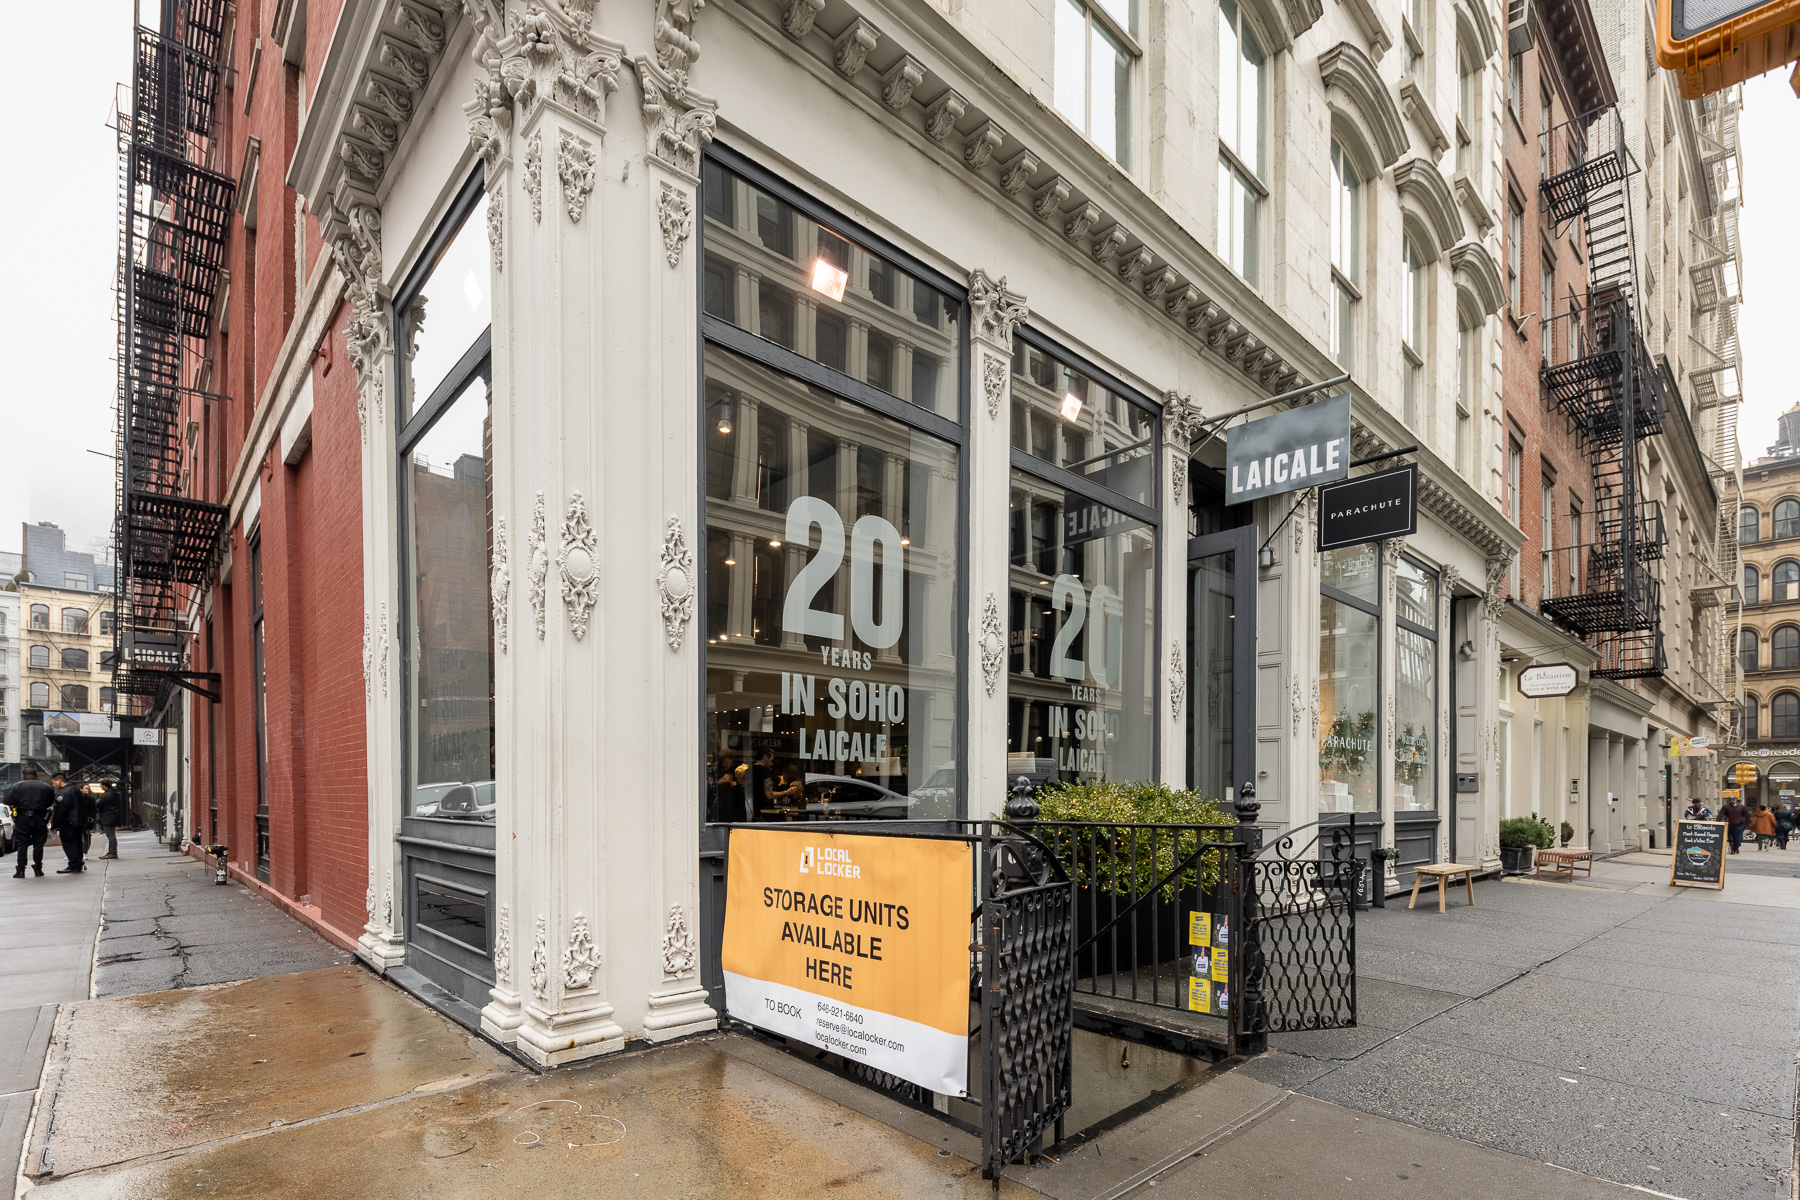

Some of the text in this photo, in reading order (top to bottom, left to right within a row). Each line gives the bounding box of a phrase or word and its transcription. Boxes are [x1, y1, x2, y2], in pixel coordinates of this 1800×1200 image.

[1232, 438, 1340, 494] LAICALE
[1330, 498, 1402, 520] PARACHUTE
[782, 495, 904, 649] 20
[1050, 573, 1121, 689] 20
[124, 647, 179, 664] LAICALE
[821, 645, 872, 671] YEARS
[781, 671, 905, 724] IN SOHO
[1071, 684, 1101, 703] YEARS
[1049, 705, 1121, 743] IN SOHO
[799, 727, 888, 764] LAICALE
[1321, 734, 1373, 752] PARACHUTE
[816, 846, 853, 863] LOCAL
[816, 861, 862, 880] LOCKER
[763, 886, 910, 931] STORAGE UNITS
[781, 921, 883, 961] AVAILABLE
[806, 956, 853, 990] HERE
[764, 997, 802, 1019] TO BOOK
[817, 1001, 864, 1025] 646-921-6640
[815, 1029, 867, 1056] localocker.com
[816, 1017, 905, 1053] reserve@localocker.com
